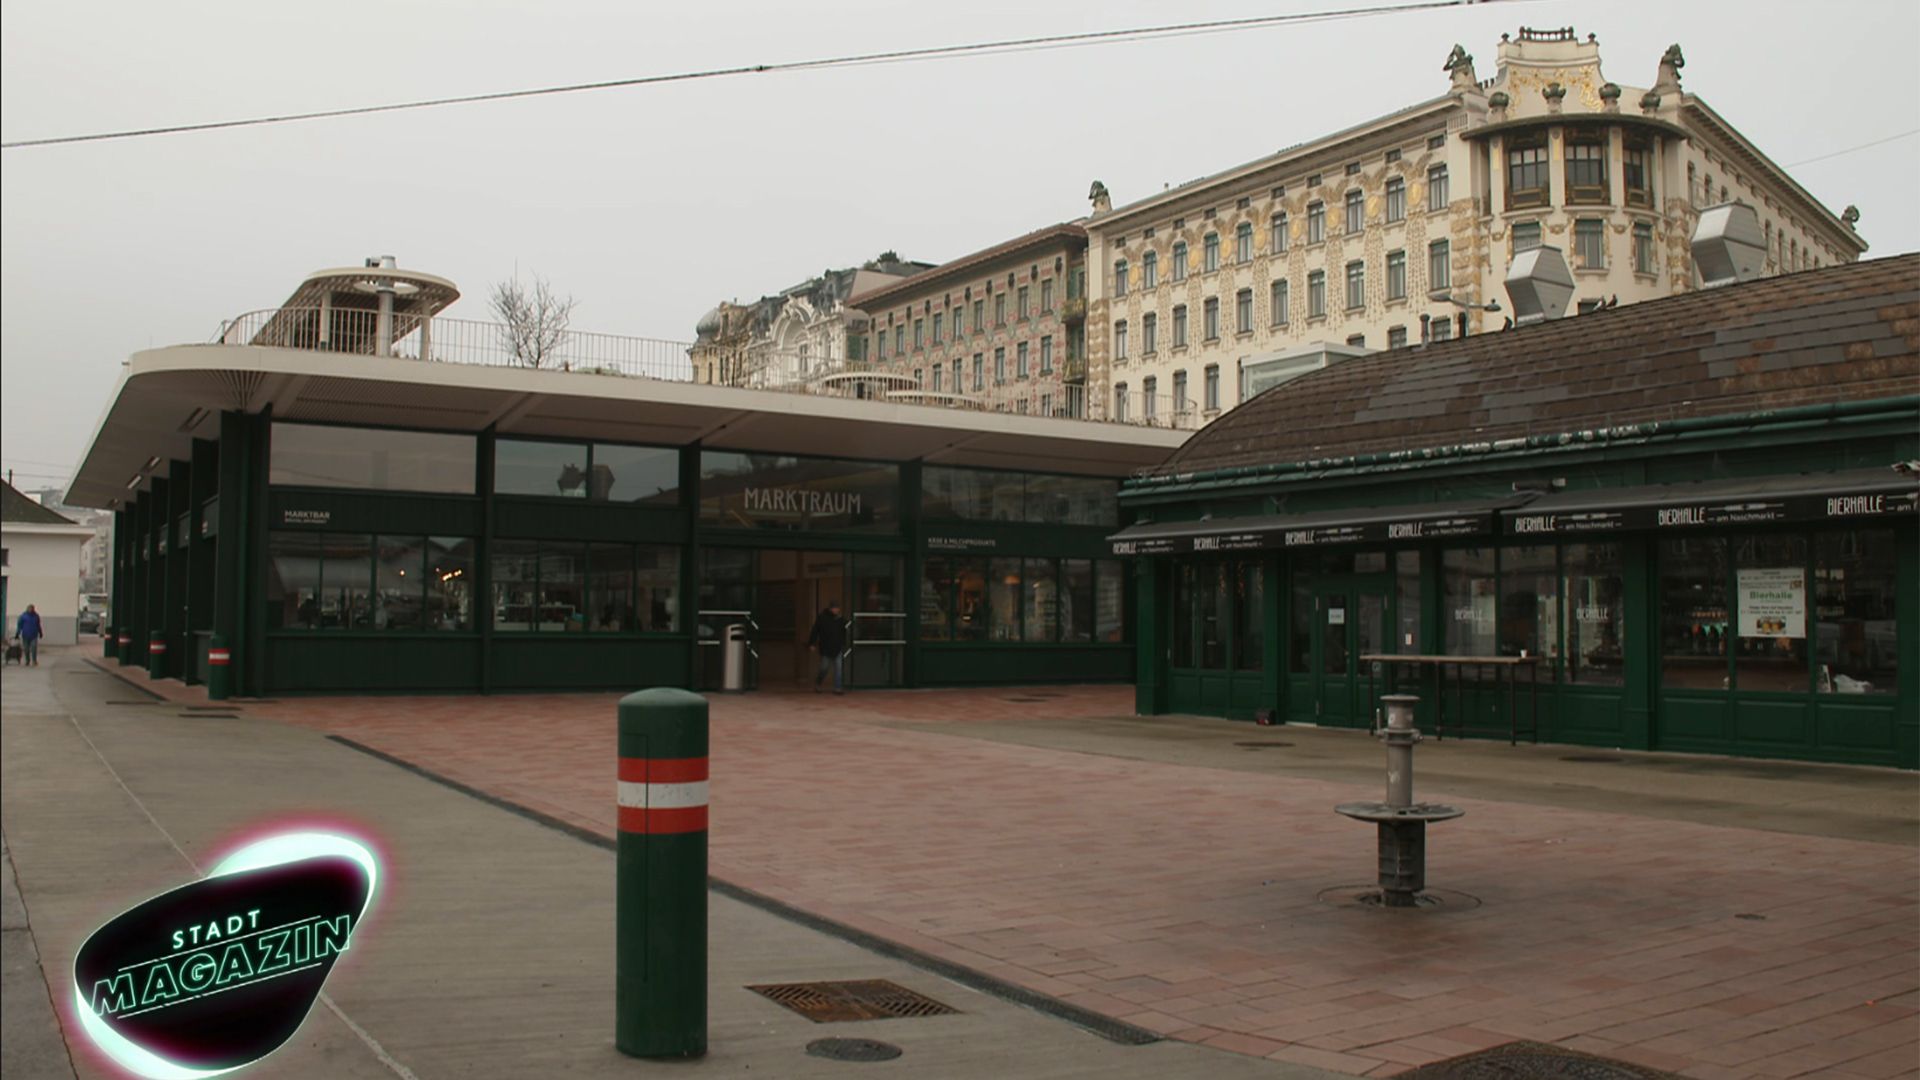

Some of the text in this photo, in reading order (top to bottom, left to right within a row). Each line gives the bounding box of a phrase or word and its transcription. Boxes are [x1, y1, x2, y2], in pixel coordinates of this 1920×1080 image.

[744, 487, 861, 514] MARKTRAUM
[1827, 495, 1883, 516] BIERHALLE
[284, 510, 330, 519] MARKTBAR
[1657, 506, 1705, 526] BIERHALLE
[1730, 512, 1775, 521] Naschmarkt
[1388, 522, 1423, 538] BIERHALLE
[1515, 515, 1556, 533] BIERHALLE
[1576, 520, 1614, 529] Naschmarkt
[1285, 530, 1315, 545] BIERHALLE
[1749, 591, 1793, 600] Bierhalle
